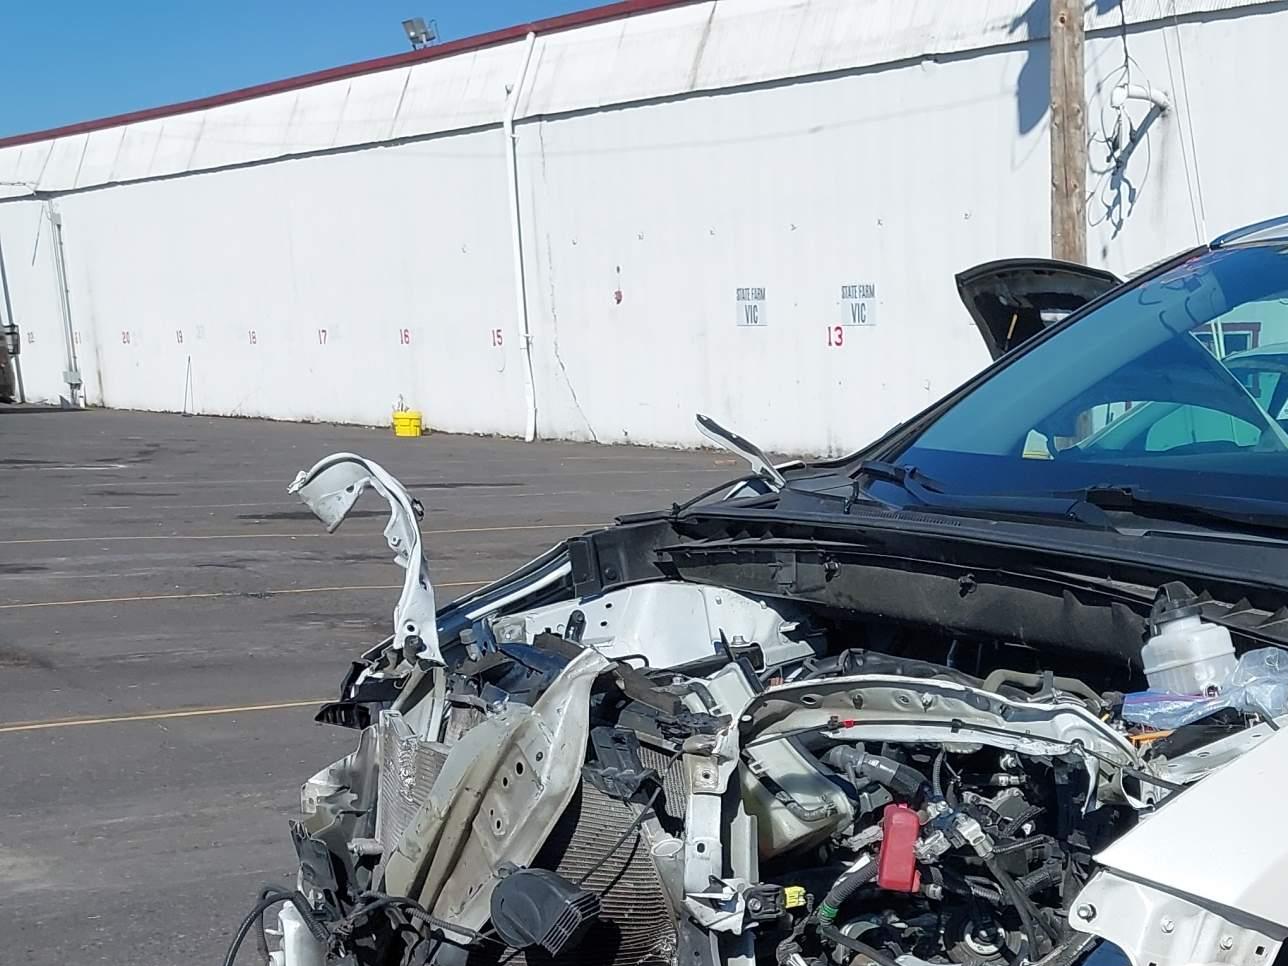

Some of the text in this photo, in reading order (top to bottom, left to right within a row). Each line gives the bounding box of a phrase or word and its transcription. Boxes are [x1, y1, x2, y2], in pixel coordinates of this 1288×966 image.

[736, 287, 766, 301] STATE FARM
[841, 284, 875, 299] STATE FARM
[744, 304, 759, 324] VIC
[851, 302, 866, 323] VIC
[317, 328, 328, 345] 17
[399, 328, 411, 345] 16
[491, 328, 503, 347] 15
[827, 326, 843, 347] 13
